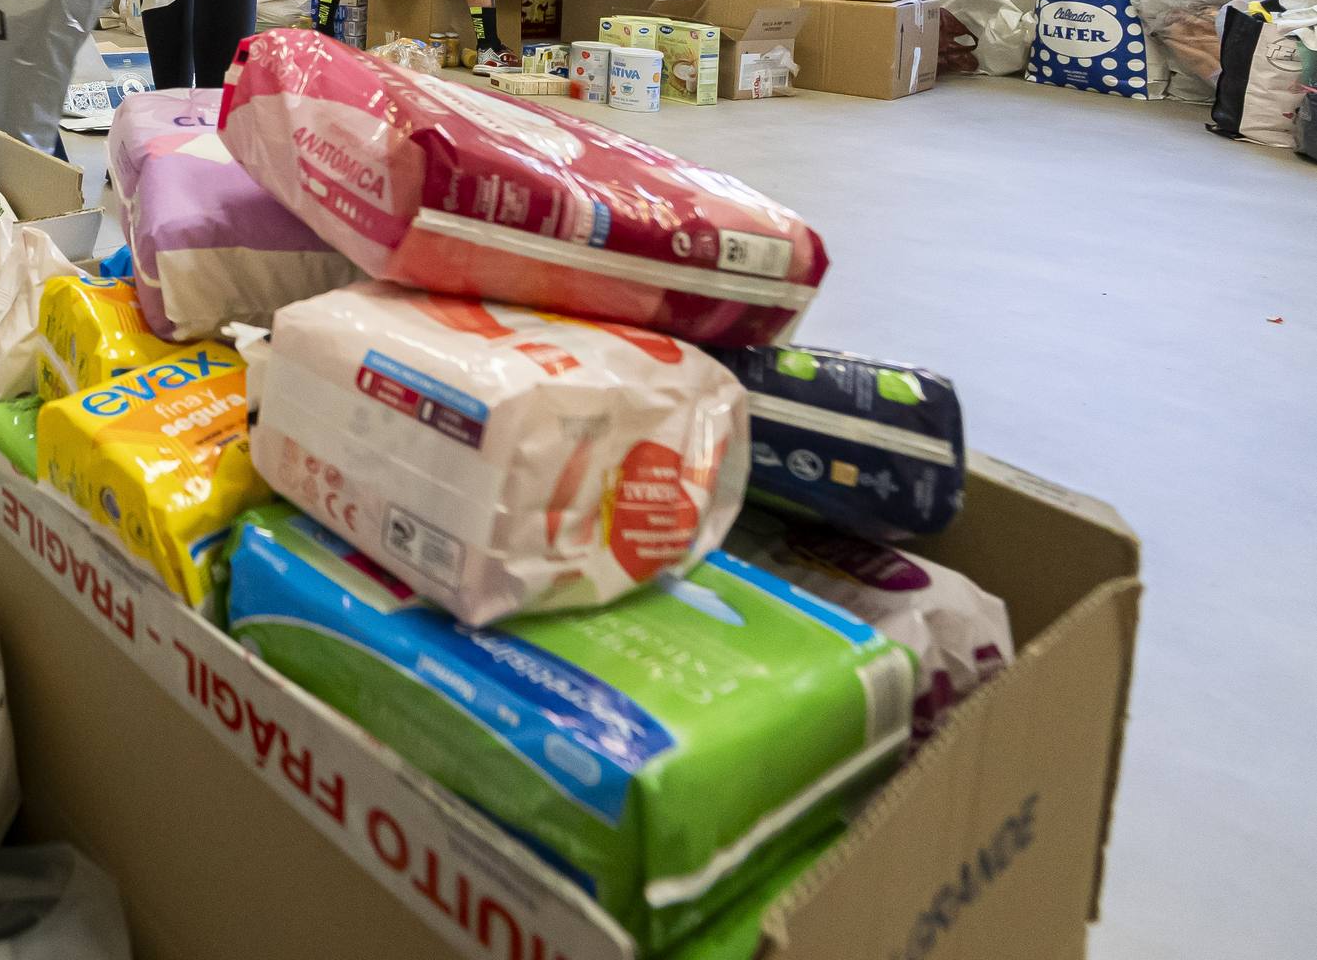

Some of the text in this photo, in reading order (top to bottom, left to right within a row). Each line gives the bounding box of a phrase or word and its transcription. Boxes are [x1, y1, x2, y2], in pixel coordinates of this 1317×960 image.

[1042, 23, 1111, 43] LAFER
[292, 126, 385, 201] ANATÓMICA
[81, 350, 235, 417] evax
[154, 394, 203, 420] fina
[160, 393, 247, 438] segura
[1, 488, 136, 640] FRAGILE
